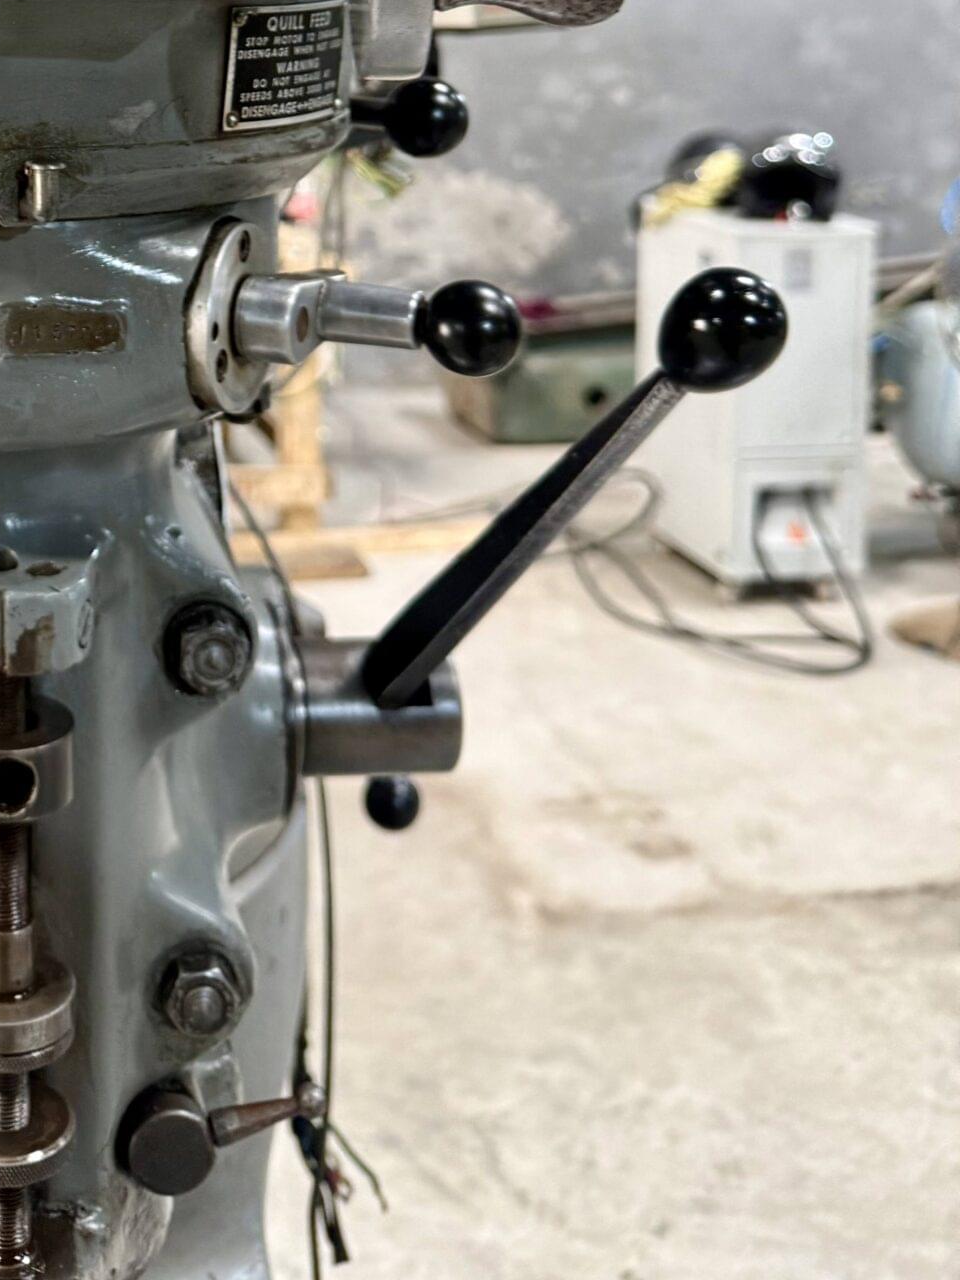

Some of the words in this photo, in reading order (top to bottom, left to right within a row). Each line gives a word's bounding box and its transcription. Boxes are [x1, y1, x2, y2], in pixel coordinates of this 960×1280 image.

[267, 14, 304, 32] QUILL
[246, 37, 268, 46] STOP
[238, 47, 289, 59] DISENGAGE
[253, 79, 267, 88] DO
[240, 91, 272, 102] SPEEDS
[277, 87, 304, 98] ABOVE
[241, 102, 297, 118] DISENGAGE
